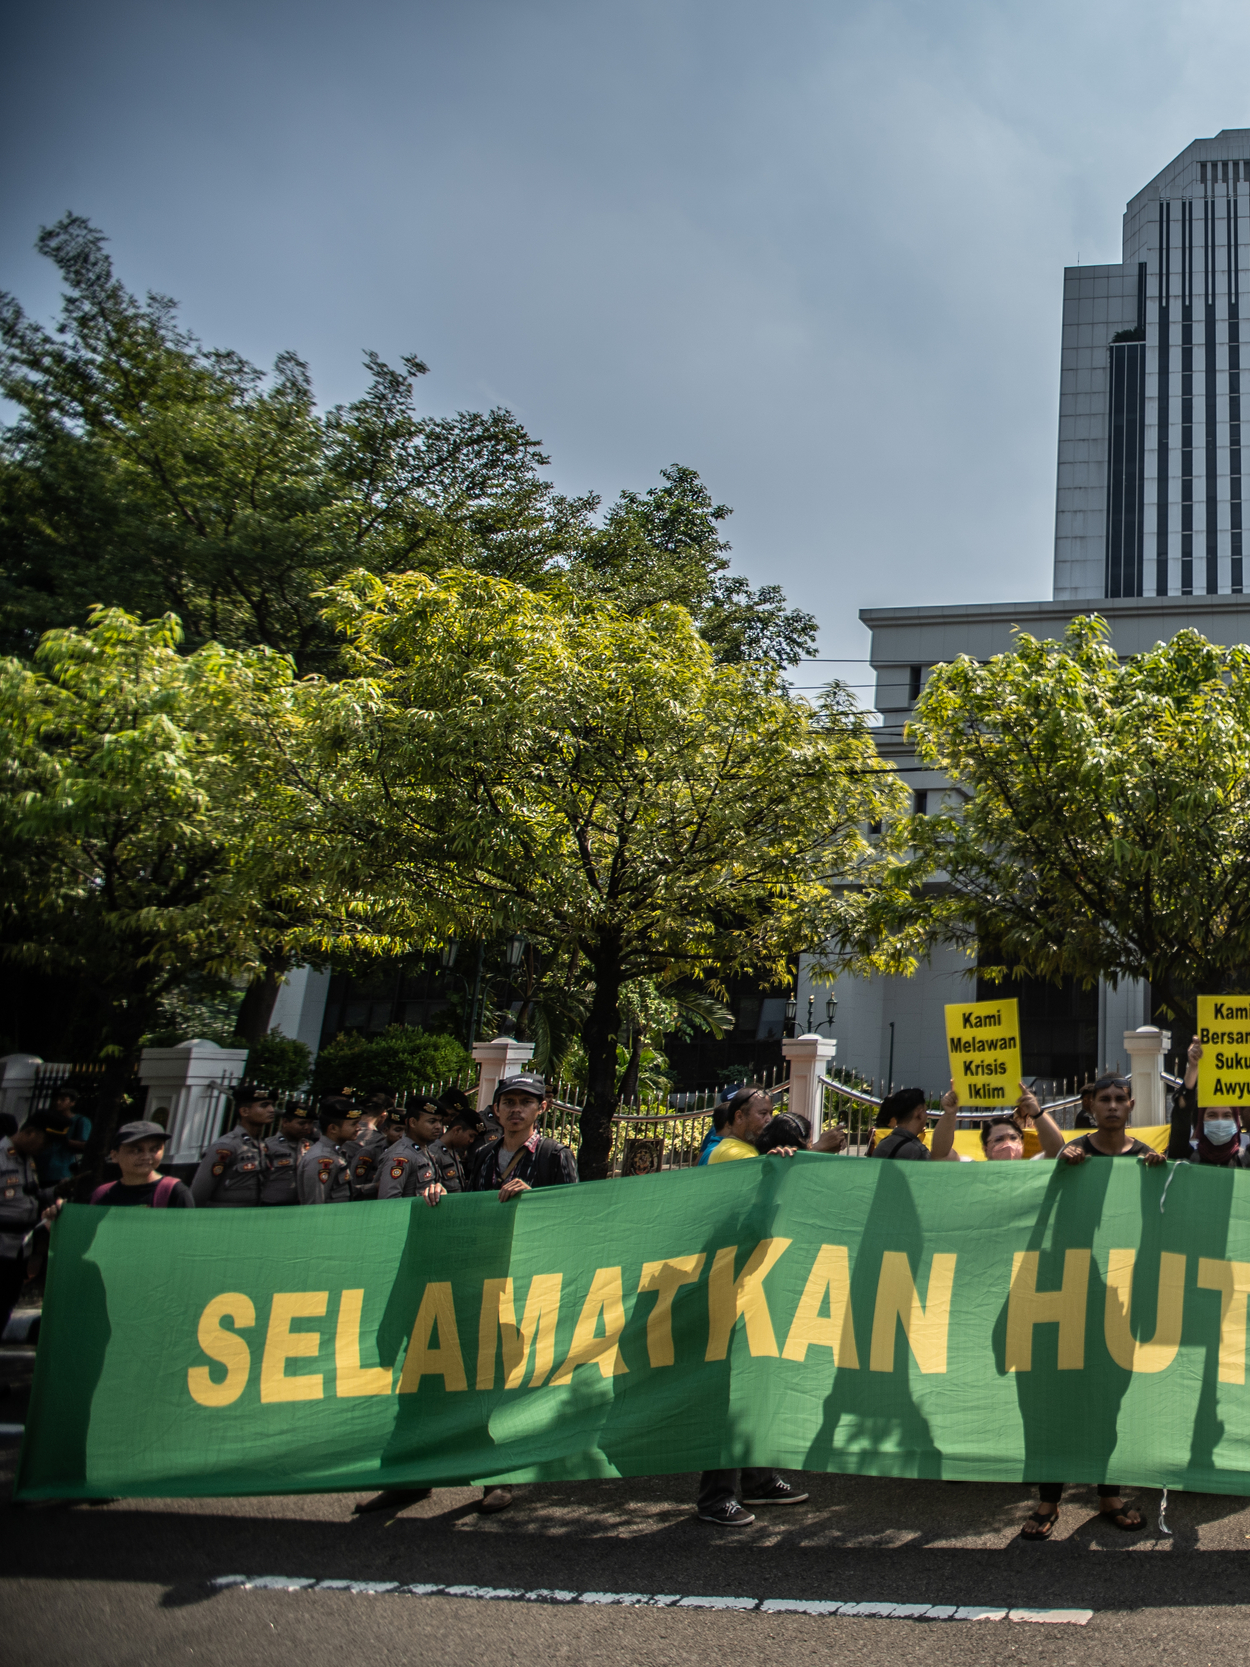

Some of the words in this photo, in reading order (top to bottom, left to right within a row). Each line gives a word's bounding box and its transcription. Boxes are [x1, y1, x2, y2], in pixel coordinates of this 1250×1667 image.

[962, 1009, 1002, 1029] Kami
[950, 1036, 1016, 1053] Melawan
[963, 1059, 1006, 1076] Krisis
[968, 1083, 1005, 1099] Iklim
[188, 1238, 956, 1407] SELAMATKAN
